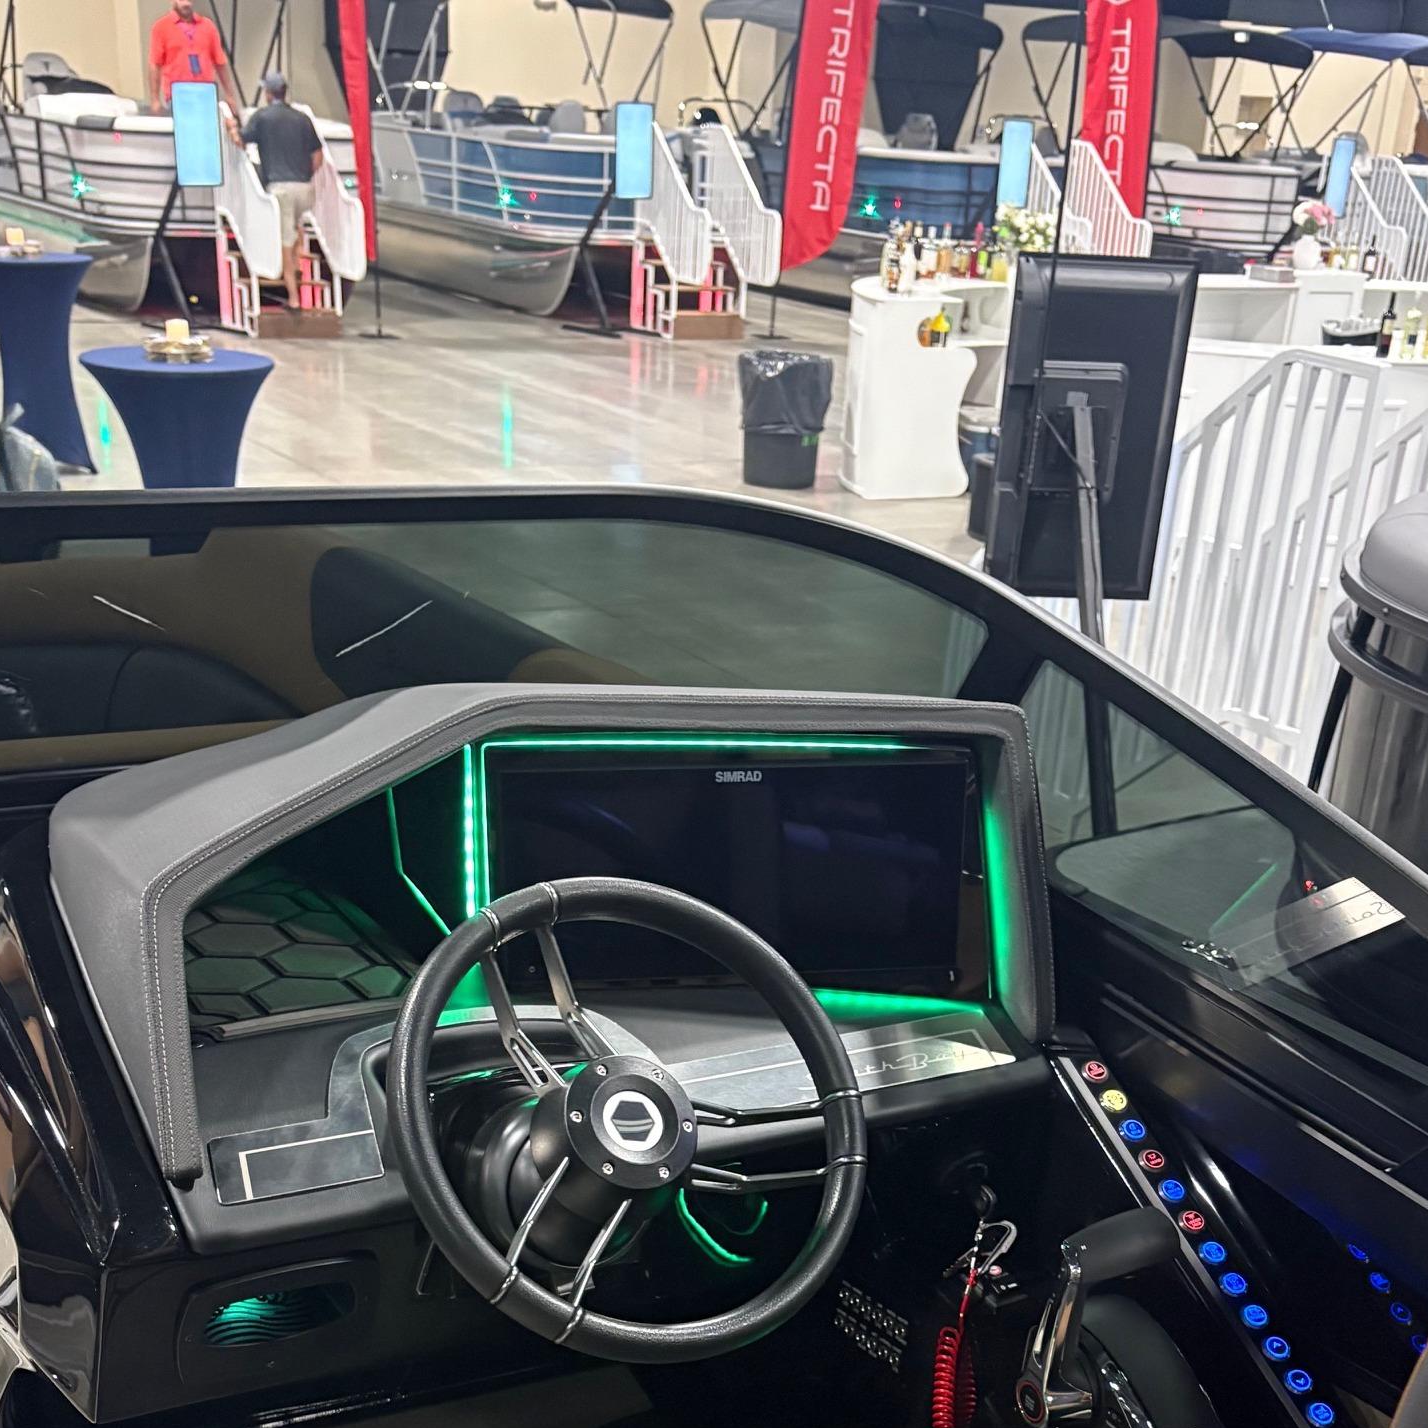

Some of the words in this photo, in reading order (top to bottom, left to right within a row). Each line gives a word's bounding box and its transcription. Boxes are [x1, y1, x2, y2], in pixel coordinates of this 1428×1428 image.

[809, 0, 855, 212] TRIFECTA
[1104, 17, 1132, 188] TRIFECT
[715, 770, 763, 783] SIMRAD
